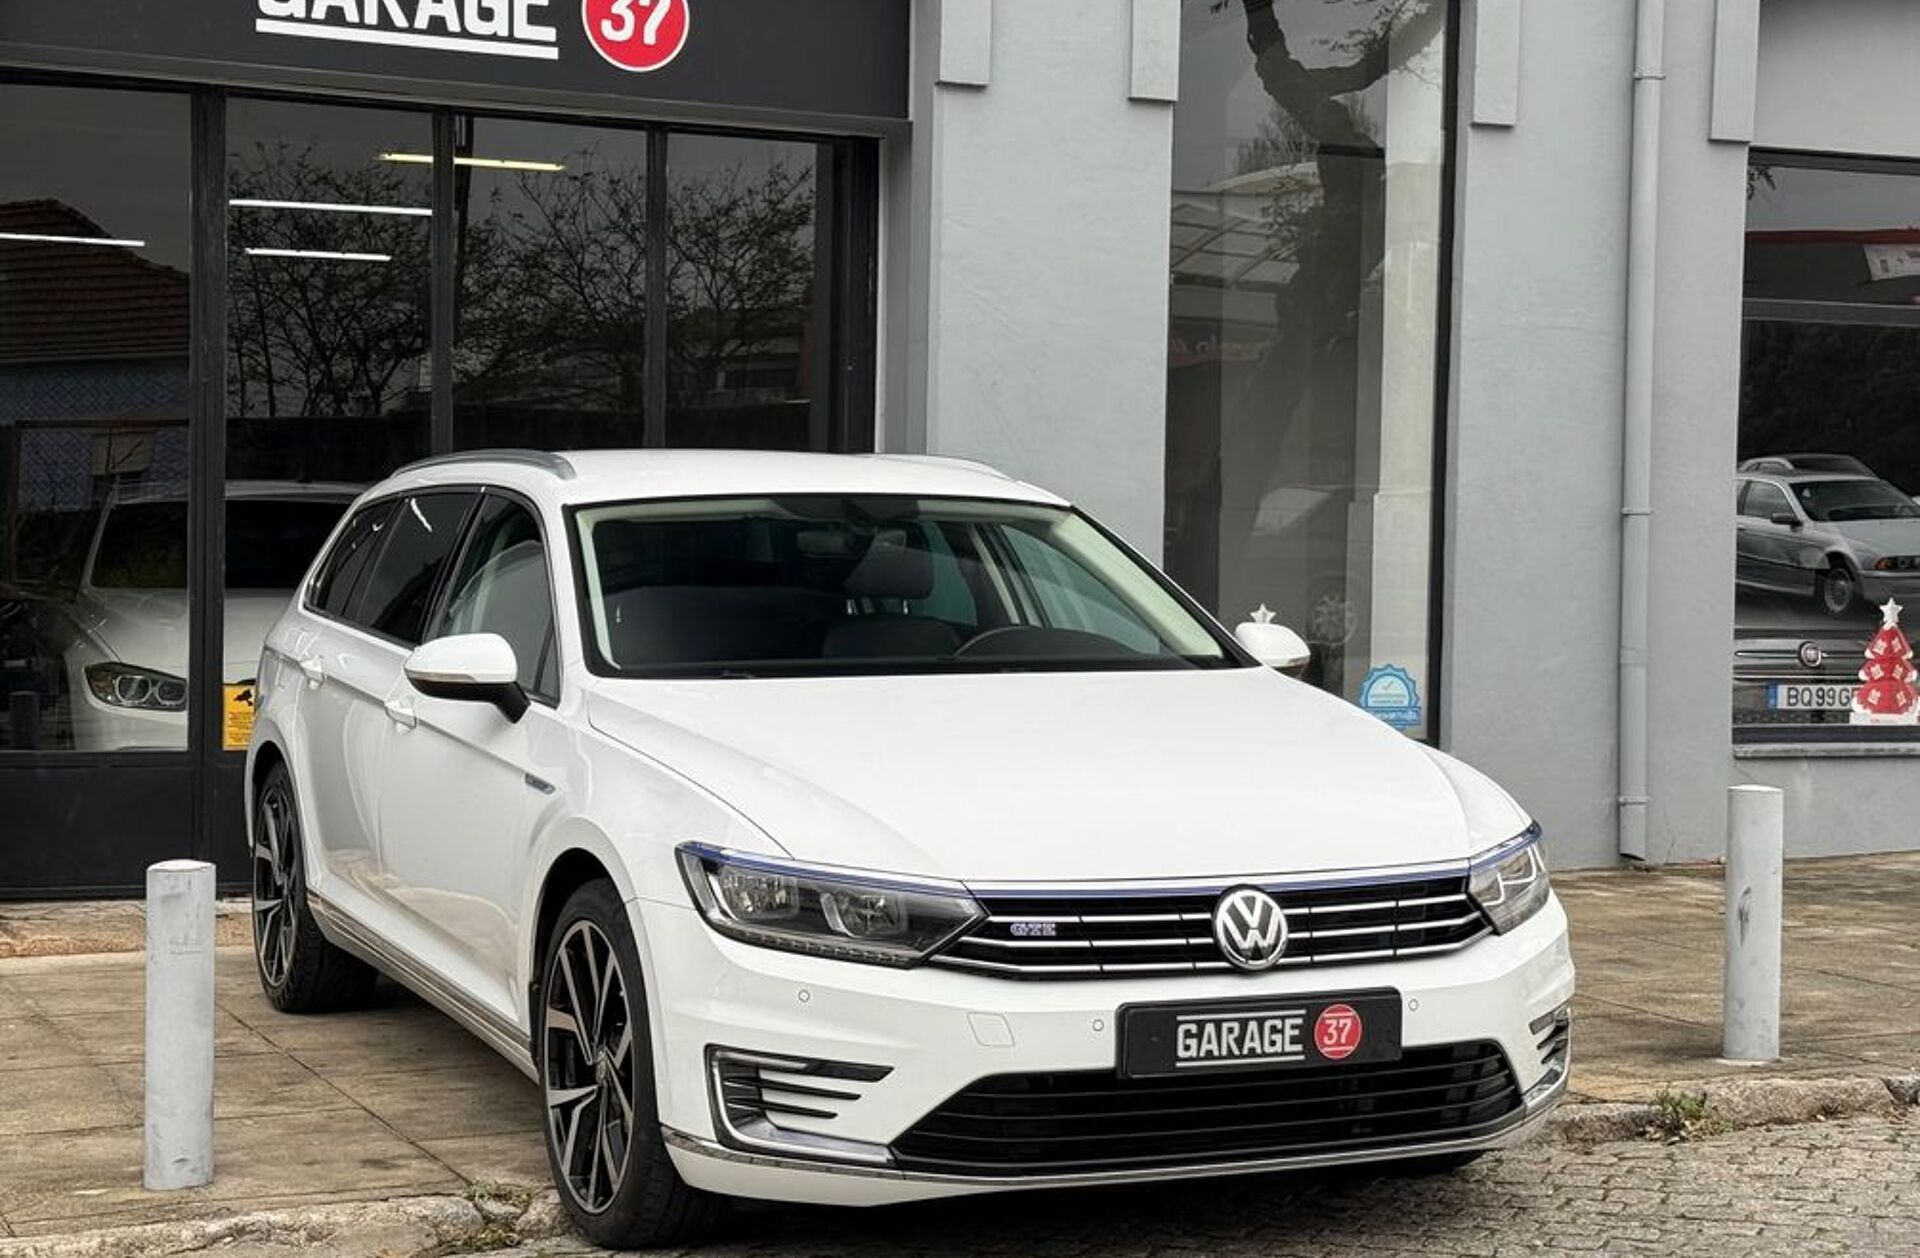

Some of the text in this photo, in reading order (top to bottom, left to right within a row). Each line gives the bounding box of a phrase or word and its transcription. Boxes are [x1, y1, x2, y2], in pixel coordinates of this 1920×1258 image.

[601, 0, 672, 45] 37
[1815, 686, 1836, 707] 99
[1176, 1018, 1352, 1058] GARAGE 37
